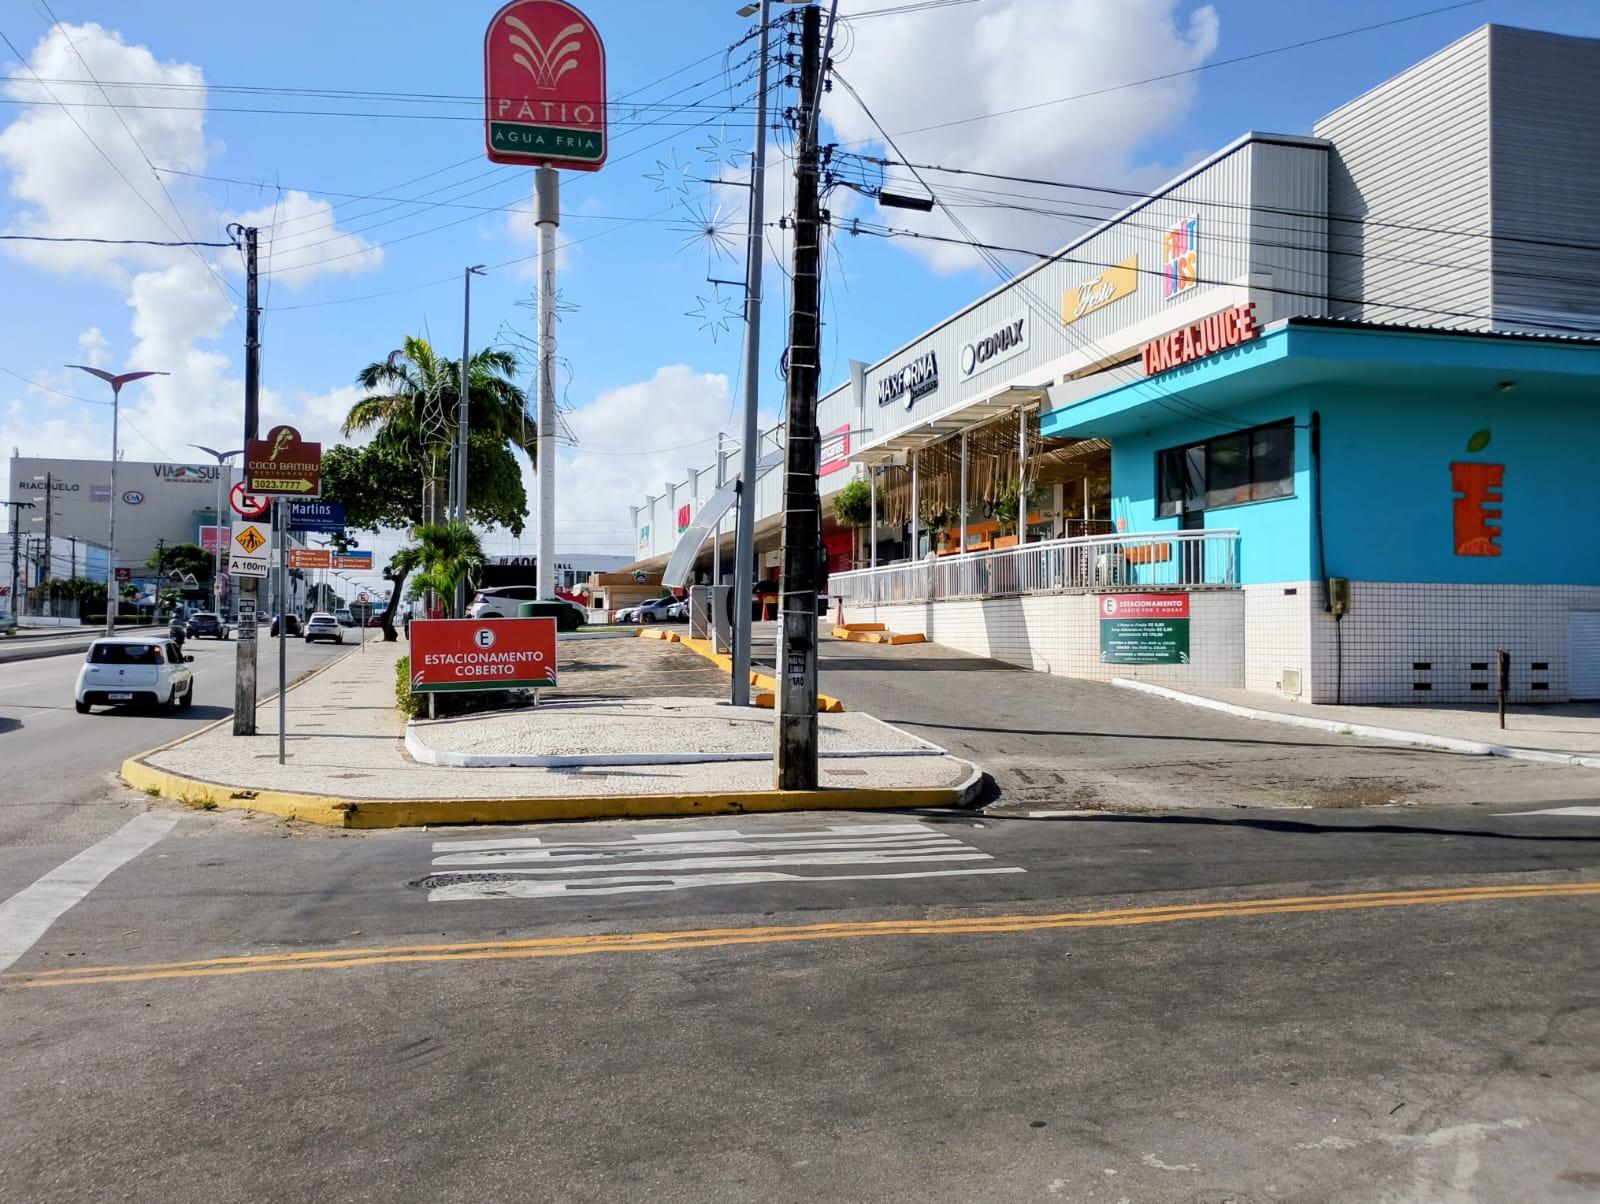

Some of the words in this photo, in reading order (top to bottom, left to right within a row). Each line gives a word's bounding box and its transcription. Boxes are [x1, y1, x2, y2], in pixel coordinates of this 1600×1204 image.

[498, 96, 595, 126] PÁTIO
[495, 129, 545, 145] ÁGUA
[556, 136, 594, 149] FRIA
[975, 319, 1024, 363] CDMAX
[153, 464, 175, 477] VIA
[249, 460, 277, 471] COCO
[280, 462, 319, 472] BAMBU
[254, 479, 301, 489] 3023.7777
[292, 503, 331, 515] Martins
[231, 560, 239, 569] A
[480, 631, 489, 646] E
[424, 650, 544, 665] ESTACIONAMENTO
[455, 664, 515, 677] COBERTO
